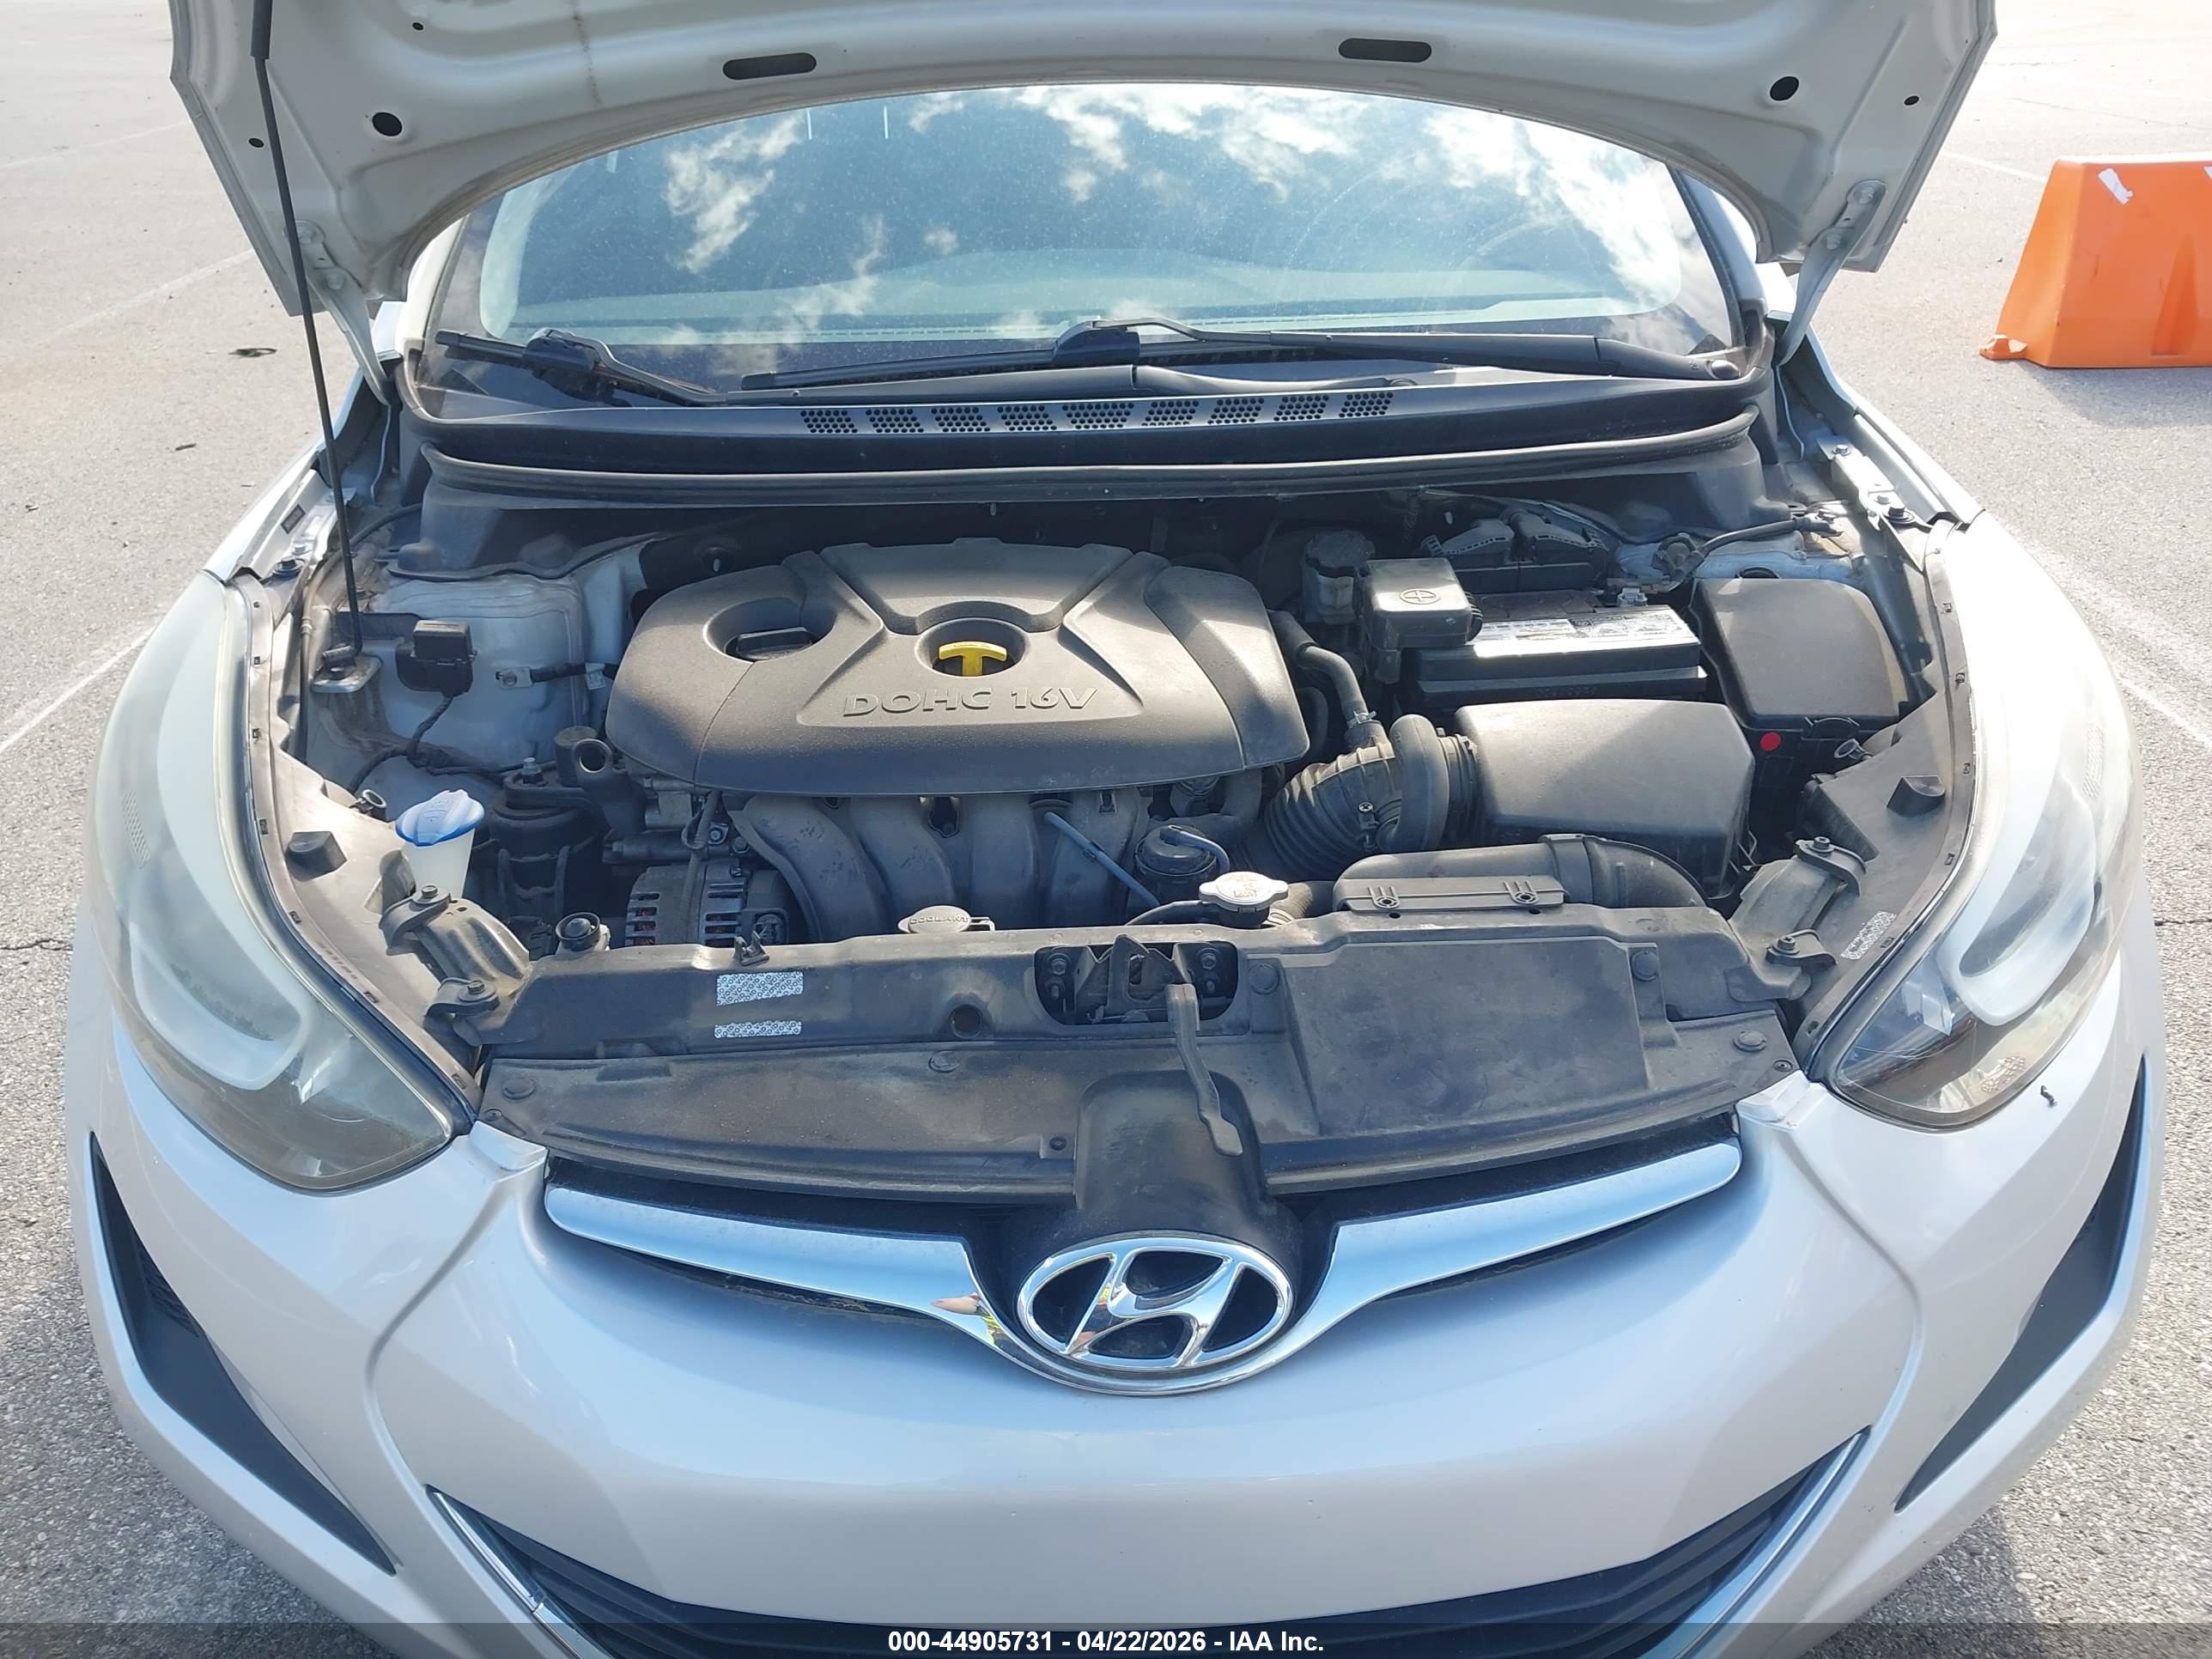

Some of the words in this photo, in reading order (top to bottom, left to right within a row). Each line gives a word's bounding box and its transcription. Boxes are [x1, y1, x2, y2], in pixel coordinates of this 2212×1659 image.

[843, 687, 992, 718] DOHC
[1011, 687, 1097, 710] 16V
[909, 915, 969, 925] COOLANT
